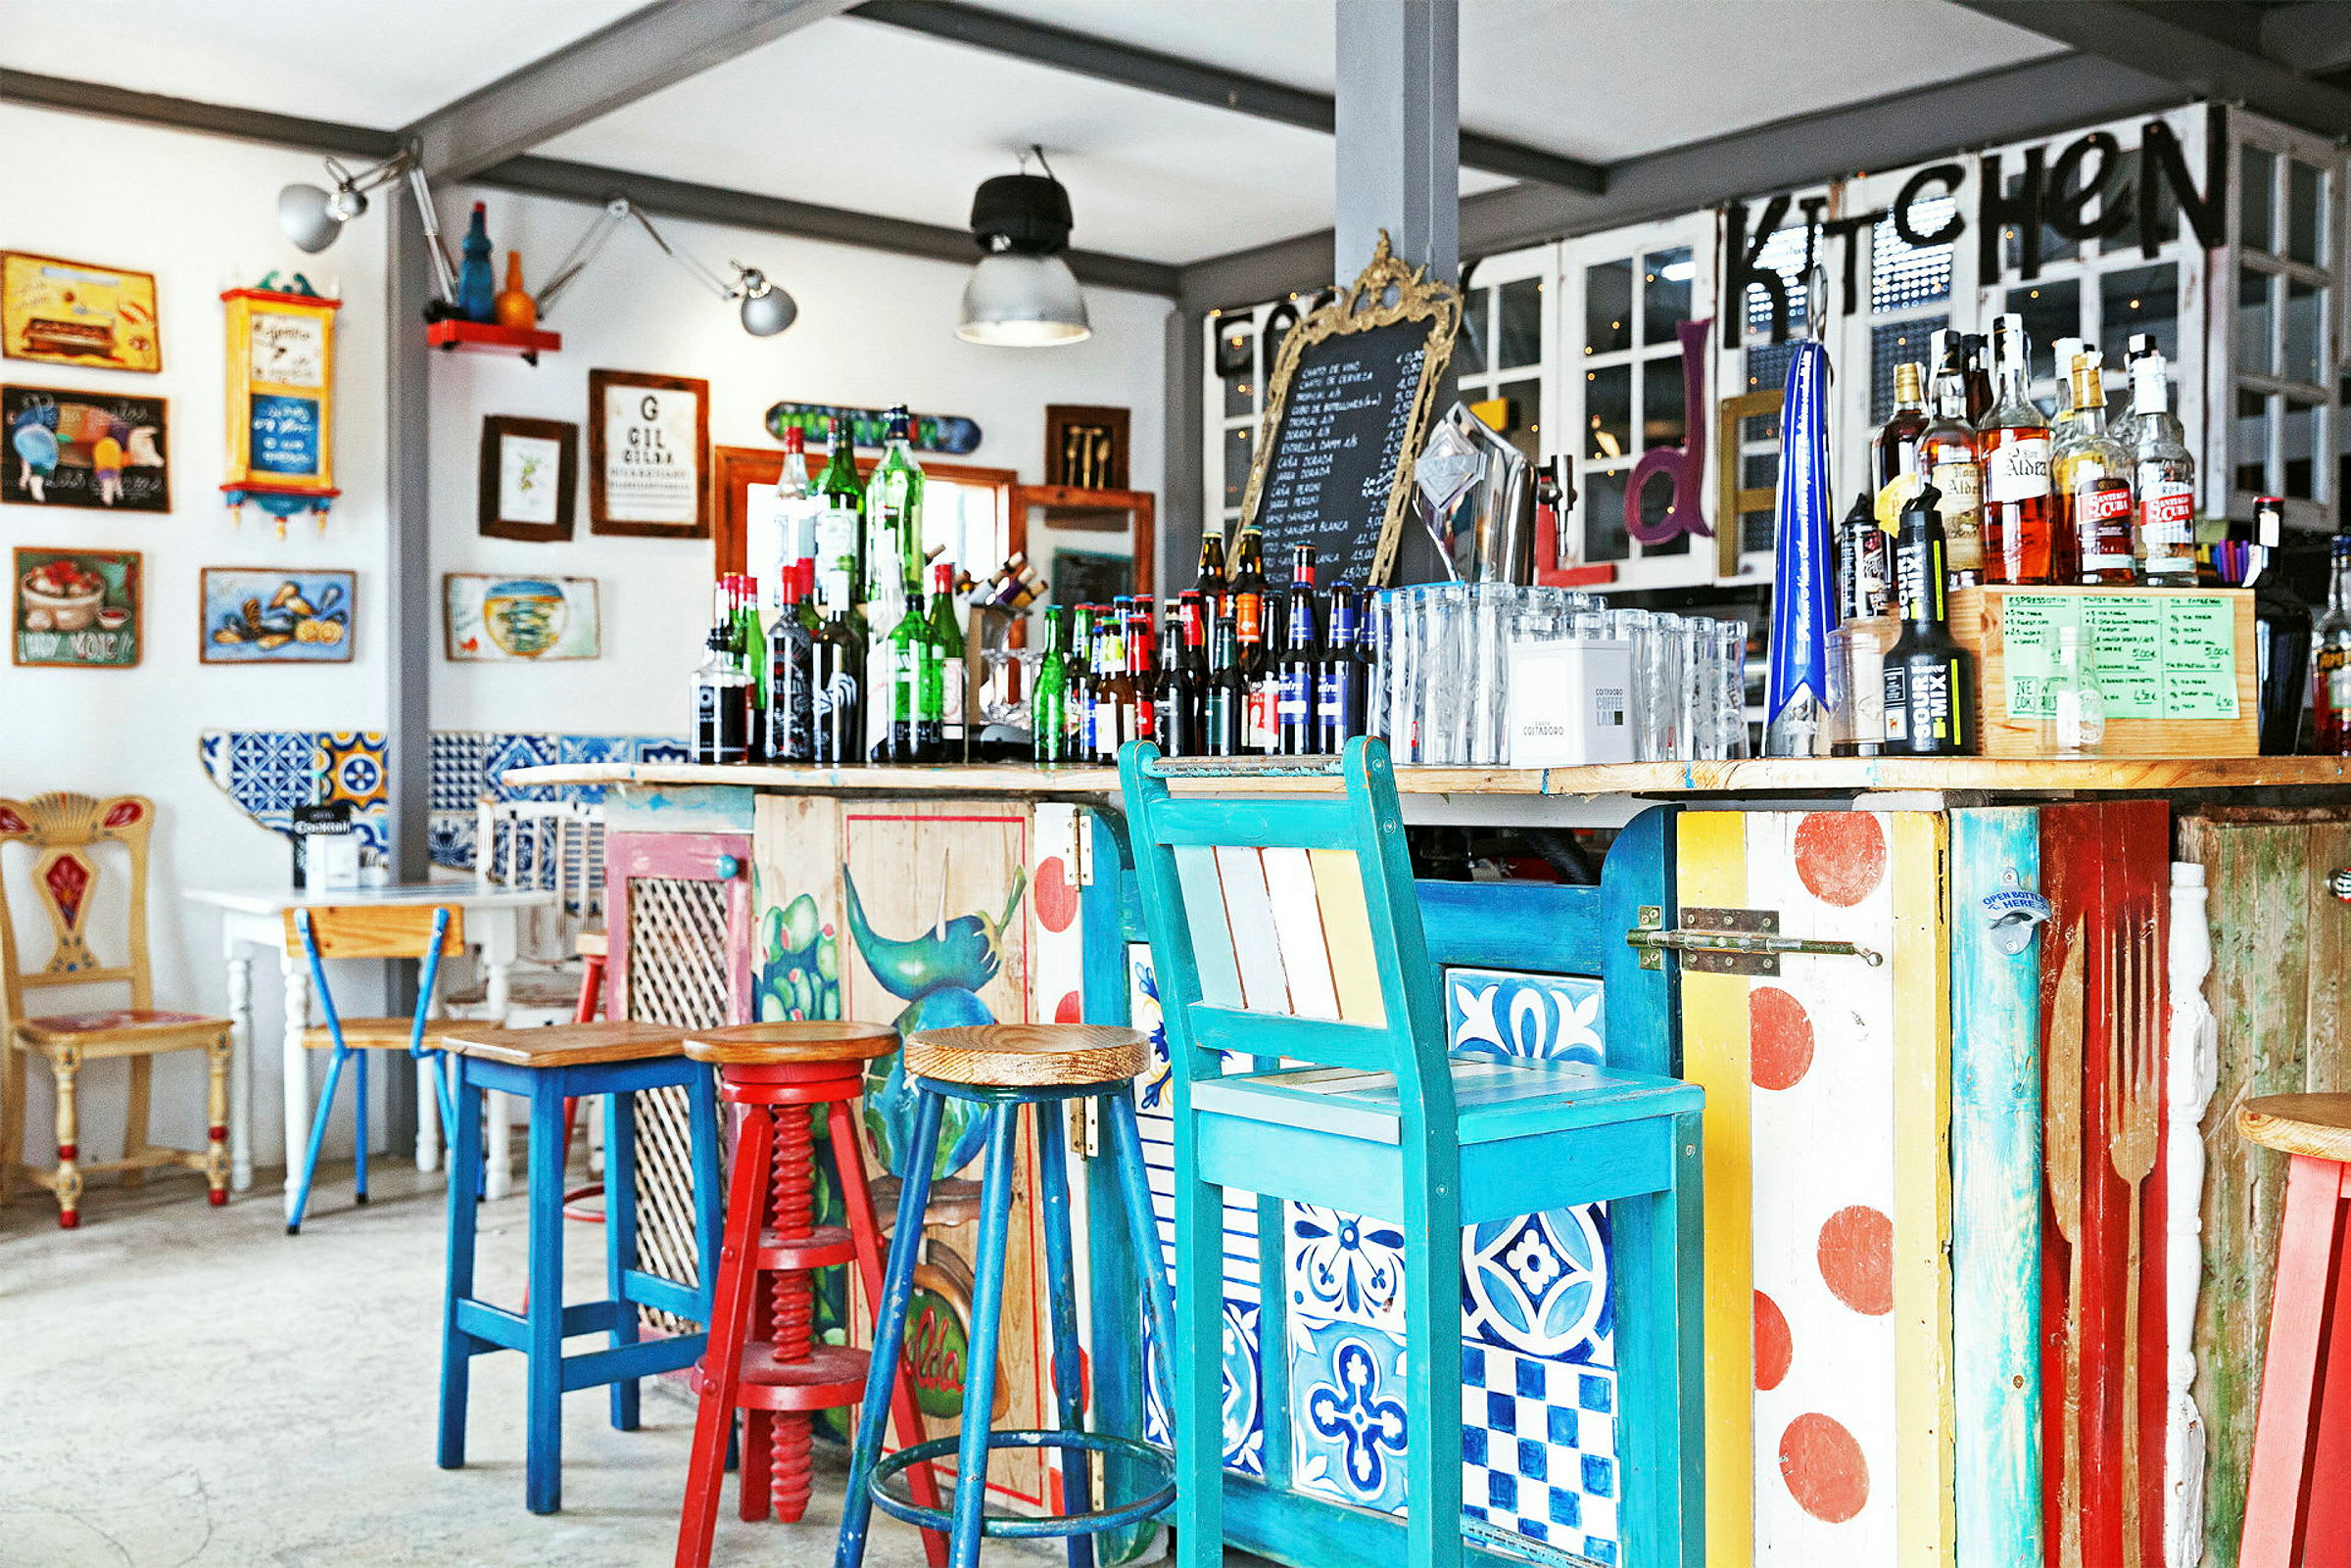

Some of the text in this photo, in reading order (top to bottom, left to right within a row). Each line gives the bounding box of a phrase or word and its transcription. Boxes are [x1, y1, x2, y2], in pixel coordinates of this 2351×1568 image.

[1722, 103, 2227, 350] KITCHEN
[641, 395, 659, 421] G
[1907, 554, 1925, 598] MIX
[1596, 696, 1623, 710] COFFEE
[1911, 675, 1931, 739] SOUR
[1930, 674, 1947, 718] MIX
[1983, 890, 2047, 906] OPEN BOTTLE
[2003, 899, 2037, 909] HERE
[906, 1305, 964, 1394] ilda
